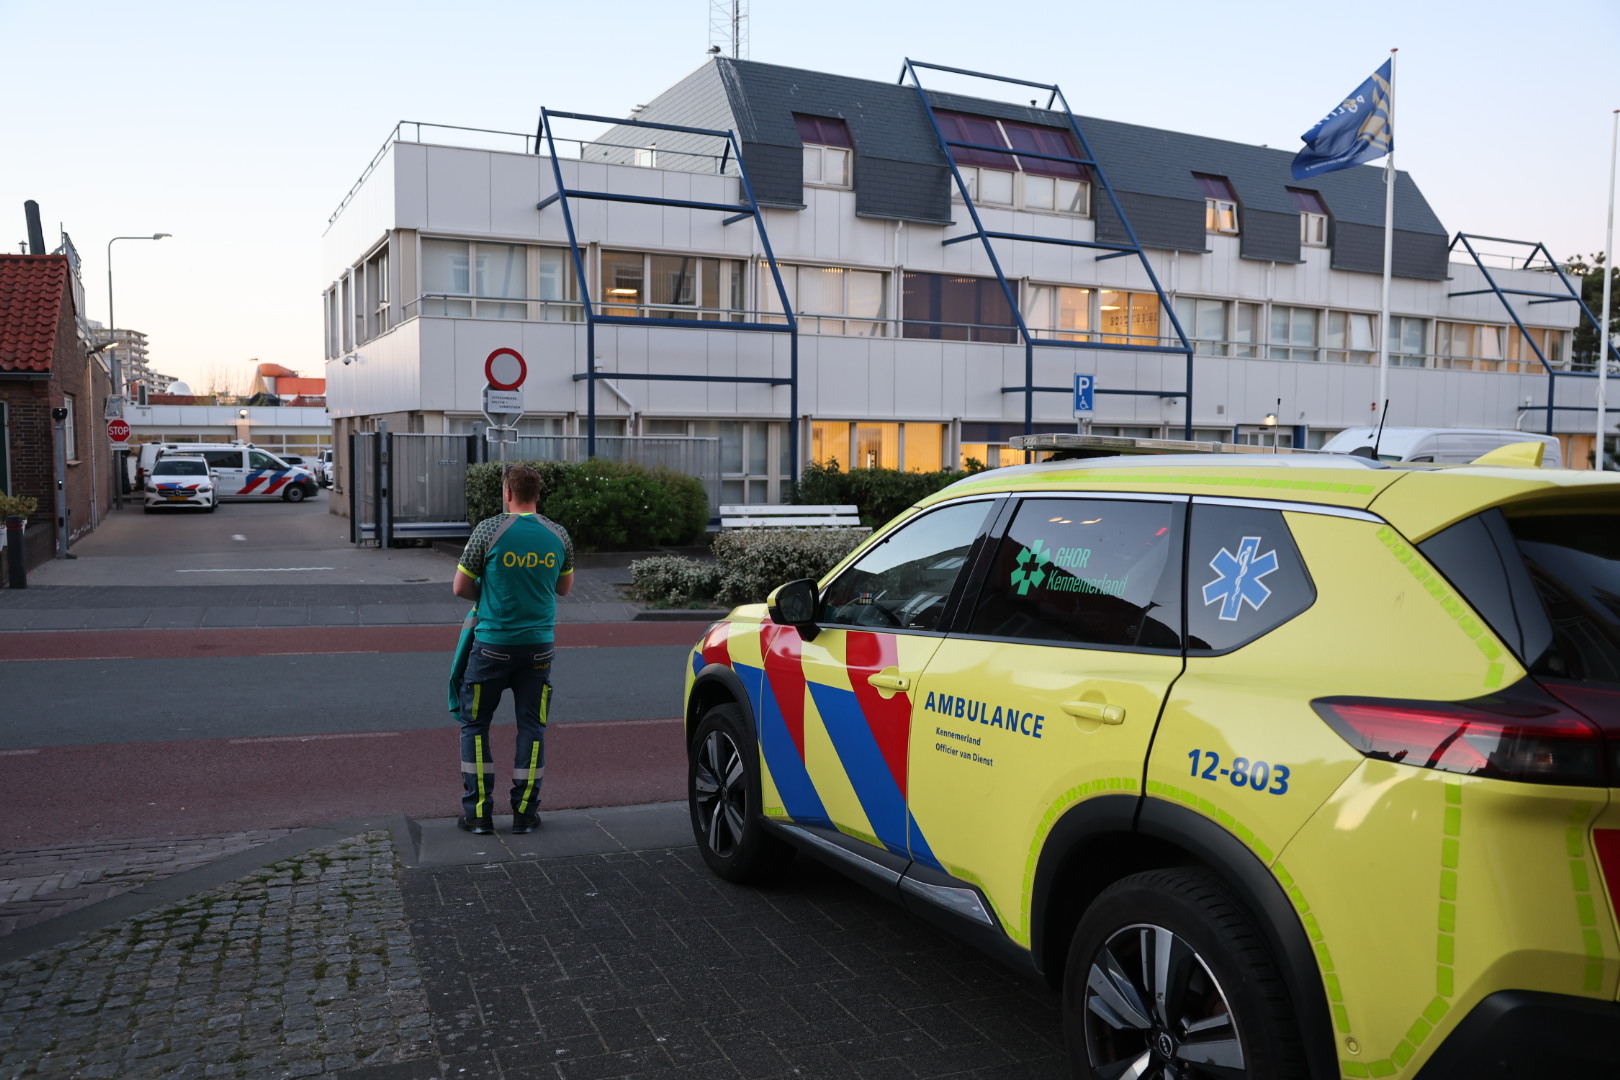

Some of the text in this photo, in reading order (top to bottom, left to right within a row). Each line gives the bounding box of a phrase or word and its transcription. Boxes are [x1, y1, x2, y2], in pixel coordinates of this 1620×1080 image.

[1079, 377, 1090, 396] P
[108, 426, 129, 436] STOP
[503, 551, 556, 568] OvD-G
[1054, 547, 1092, 568] GHOR
[1046, 569, 1129, 596] Kennemerland
[924, 691, 1045, 739] AMBULANCE
[936, 727, 982, 746] Kennemerland
[935, 742, 994, 767] Officier van Dienst
[1188, 749, 1290, 795] 12-803
